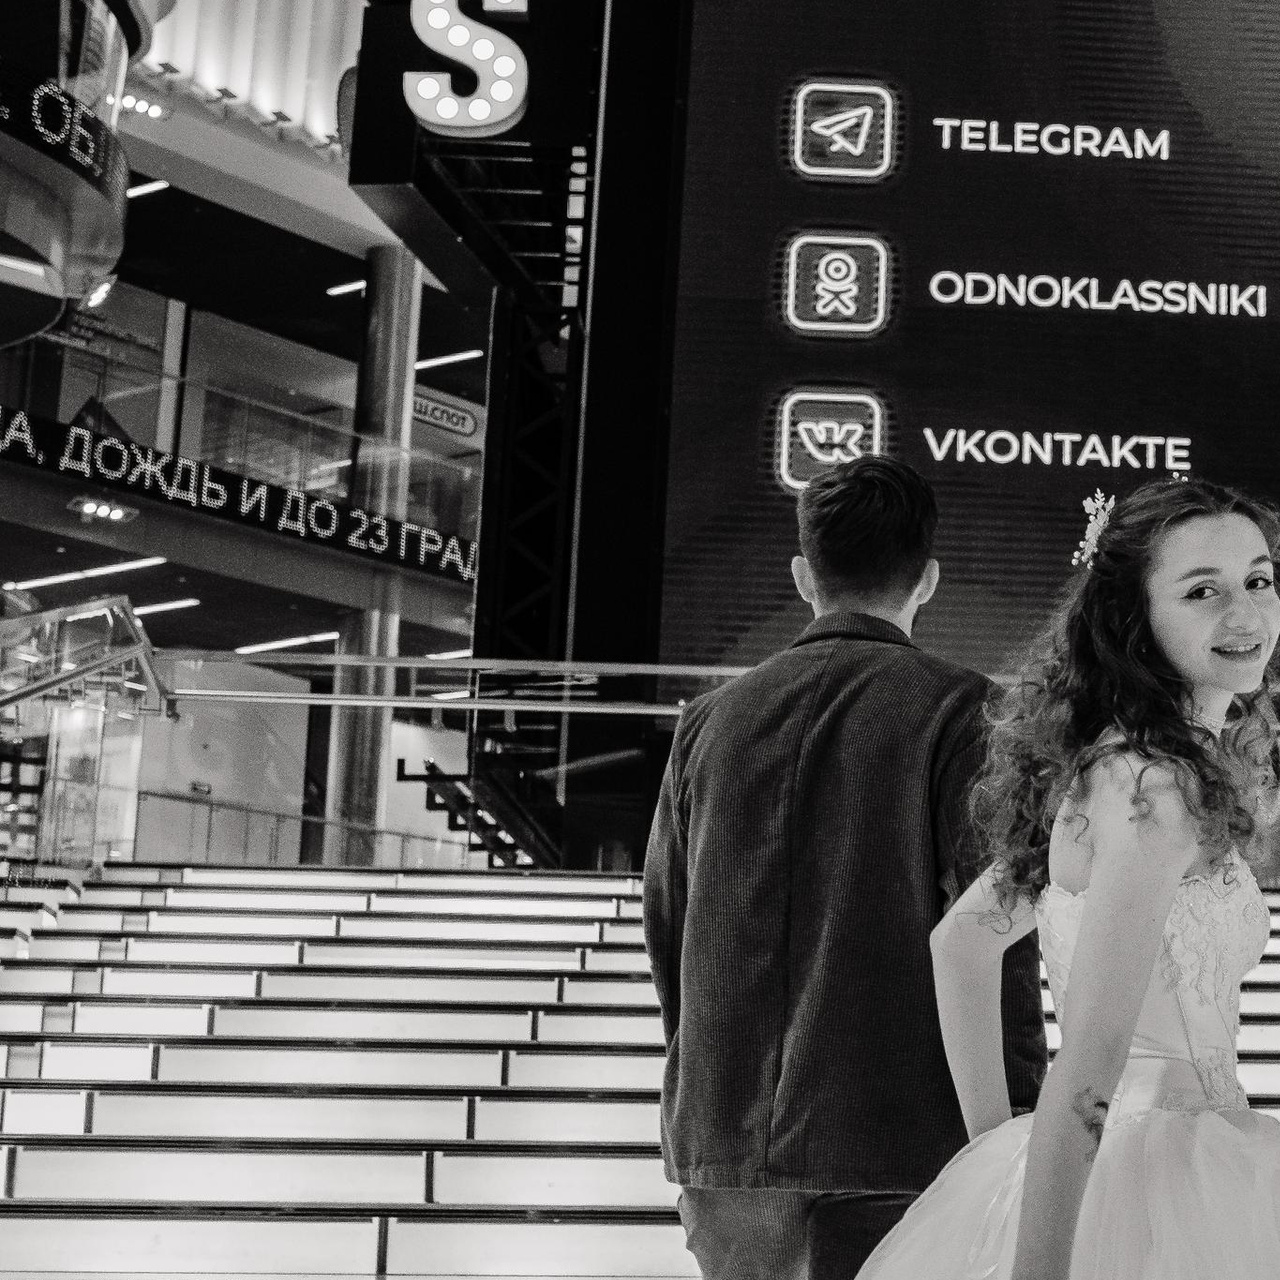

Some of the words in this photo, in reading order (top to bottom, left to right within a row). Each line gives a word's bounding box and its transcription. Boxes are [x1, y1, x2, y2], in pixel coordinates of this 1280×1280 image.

[933, 117, 1171, 161] TELEGRAM
[928, 270, 1267, 318] ODNOKLASSNIKI
[924, 427, 1192, 471] VKONTAKTE
[0, 406, 46, 465] А,
[58, 426, 228, 508] ДОЖДЬ
[239, 479, 269, 521] И
[277, 489, 339, 539] ДО
[347, 508, 389, 554] 23
